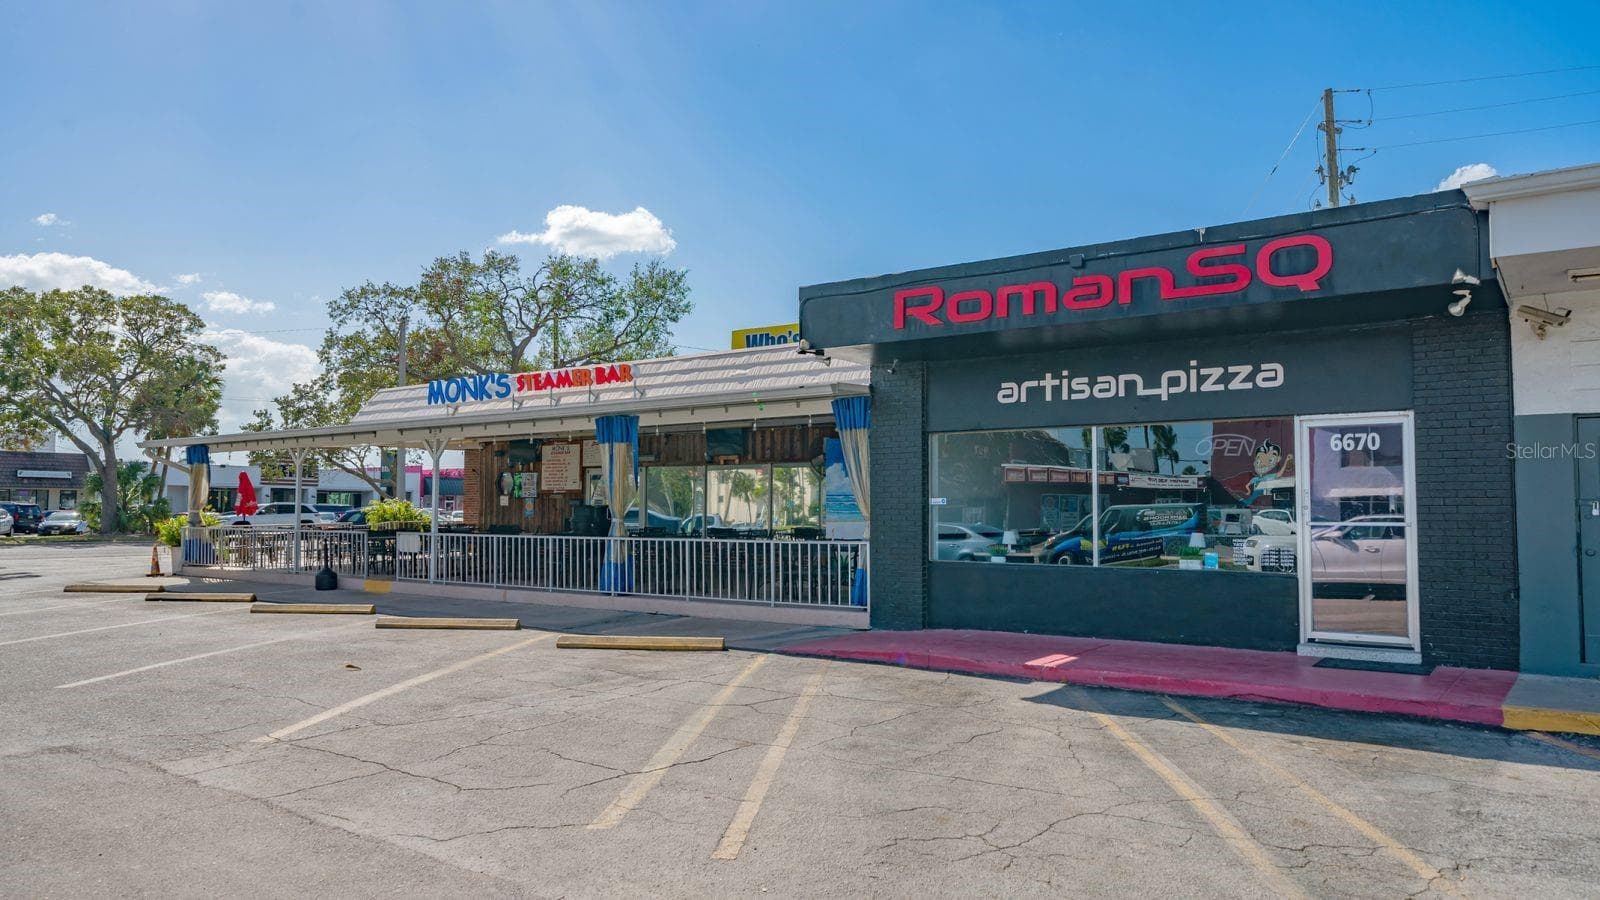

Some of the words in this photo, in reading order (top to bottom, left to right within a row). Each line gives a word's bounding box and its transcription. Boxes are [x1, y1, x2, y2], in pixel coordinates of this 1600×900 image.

[427, 373, 511, 405] MONK'S
[516, 369, 593, 392] STEAMER
[595, 364, 633, 385] BAR
[997, 370, 1145, 404] artisan
[1161, 359, 1285, 401] pizza
[1195, 436, 1257, 457] OPEN
[1330, 432, 1381, 451] 6670
